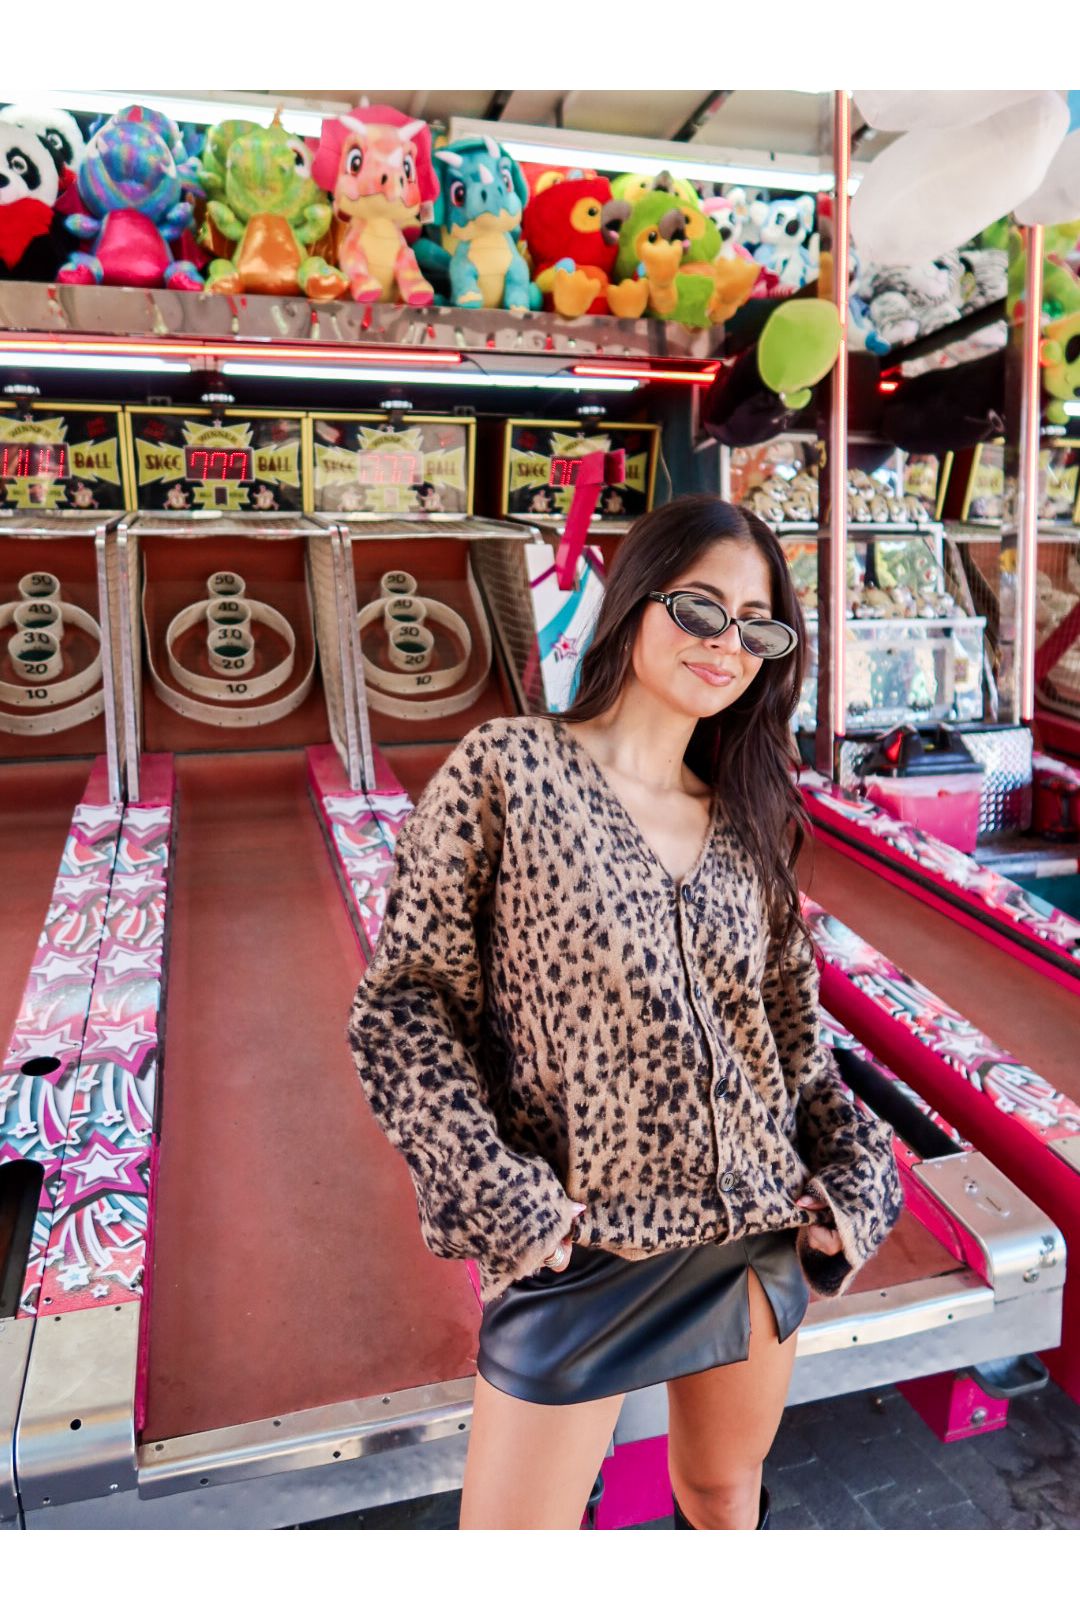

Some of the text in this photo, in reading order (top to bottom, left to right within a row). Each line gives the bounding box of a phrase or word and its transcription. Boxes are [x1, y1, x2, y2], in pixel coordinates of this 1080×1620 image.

[73, 451, 110, 469] BALL
[258, 456, 293, 473] BALL
[31, 574, 52, 586] 50
[215, 574, 235, 585] 50
[28, 603, 52, 615] 40
[218, 601, 239, 612] 40
[218, 628, 242, 640] 30
[400, 626, 420, 637] 30
[24, 632, 50, 644] 30
[222, 659, 245, 670] 20
[405, 654, 424, 665] 20
[24, 663, 48, 674] 20
[415, 675, 432, 686] 10
[25, 688, 48, 699] 10
[226, 683, 248, 694] 10
